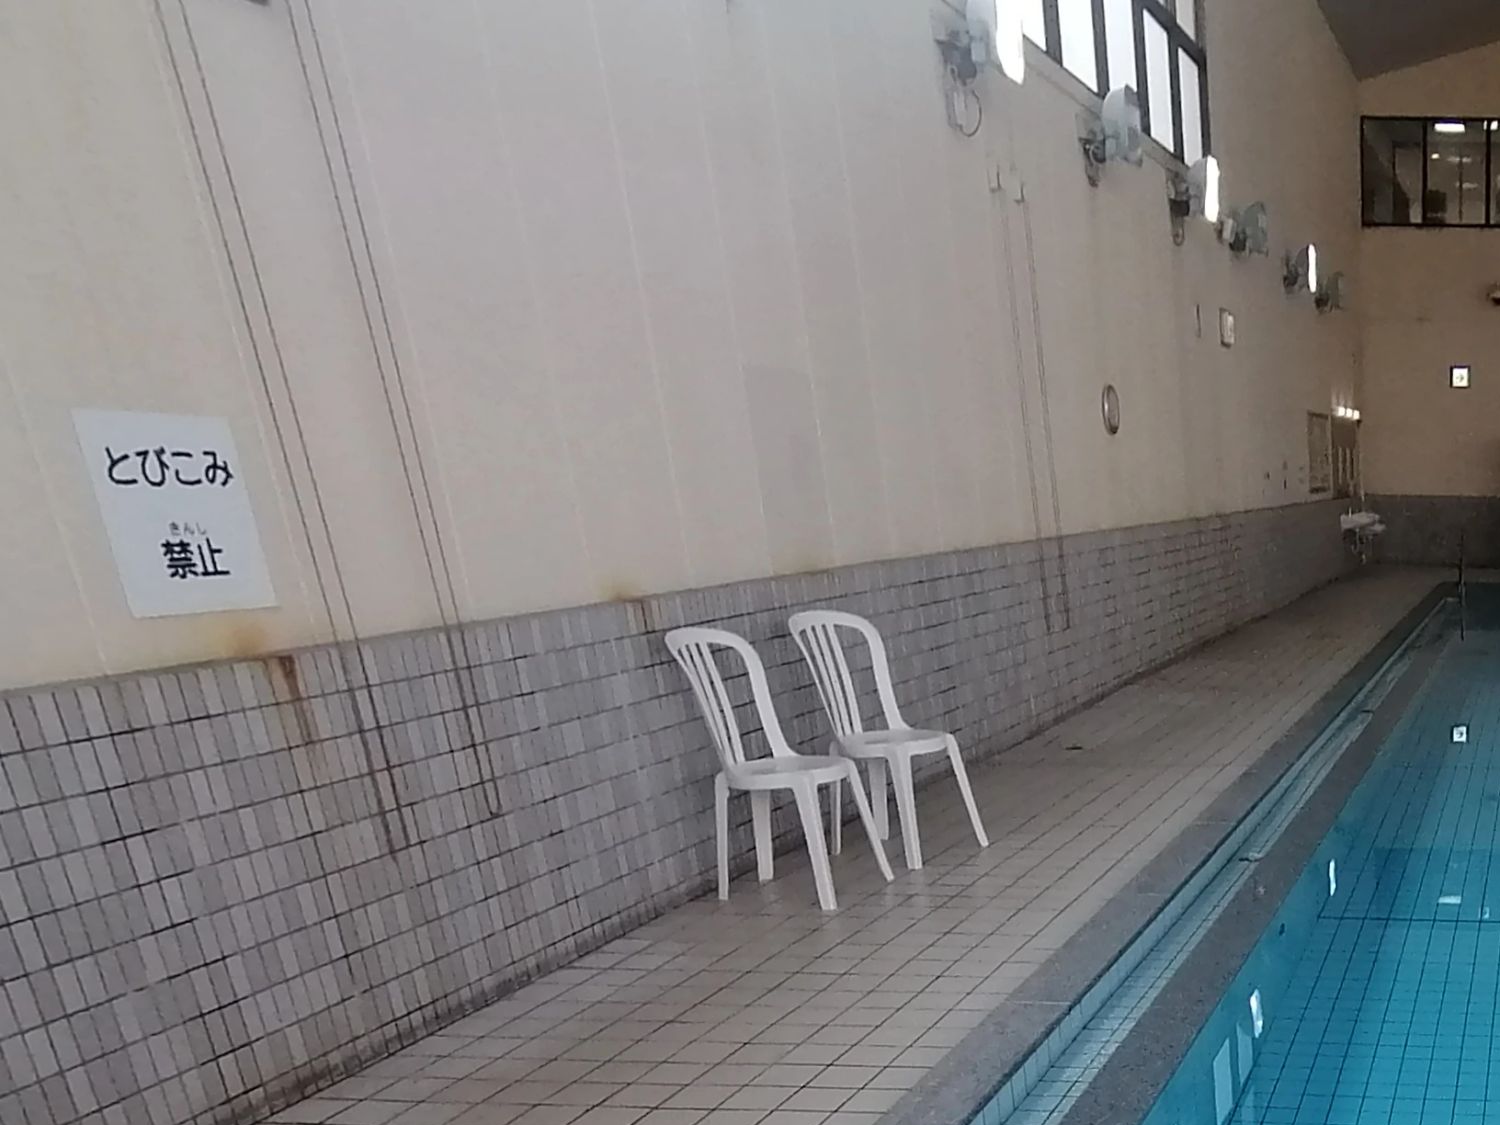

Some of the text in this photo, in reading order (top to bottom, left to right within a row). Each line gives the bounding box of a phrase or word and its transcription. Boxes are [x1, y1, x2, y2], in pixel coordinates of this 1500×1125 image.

[105, 446, 234, 487] とびこみ
[169, 521, 208, 537] きんし
[160, 537, 231, 579] 禁止
